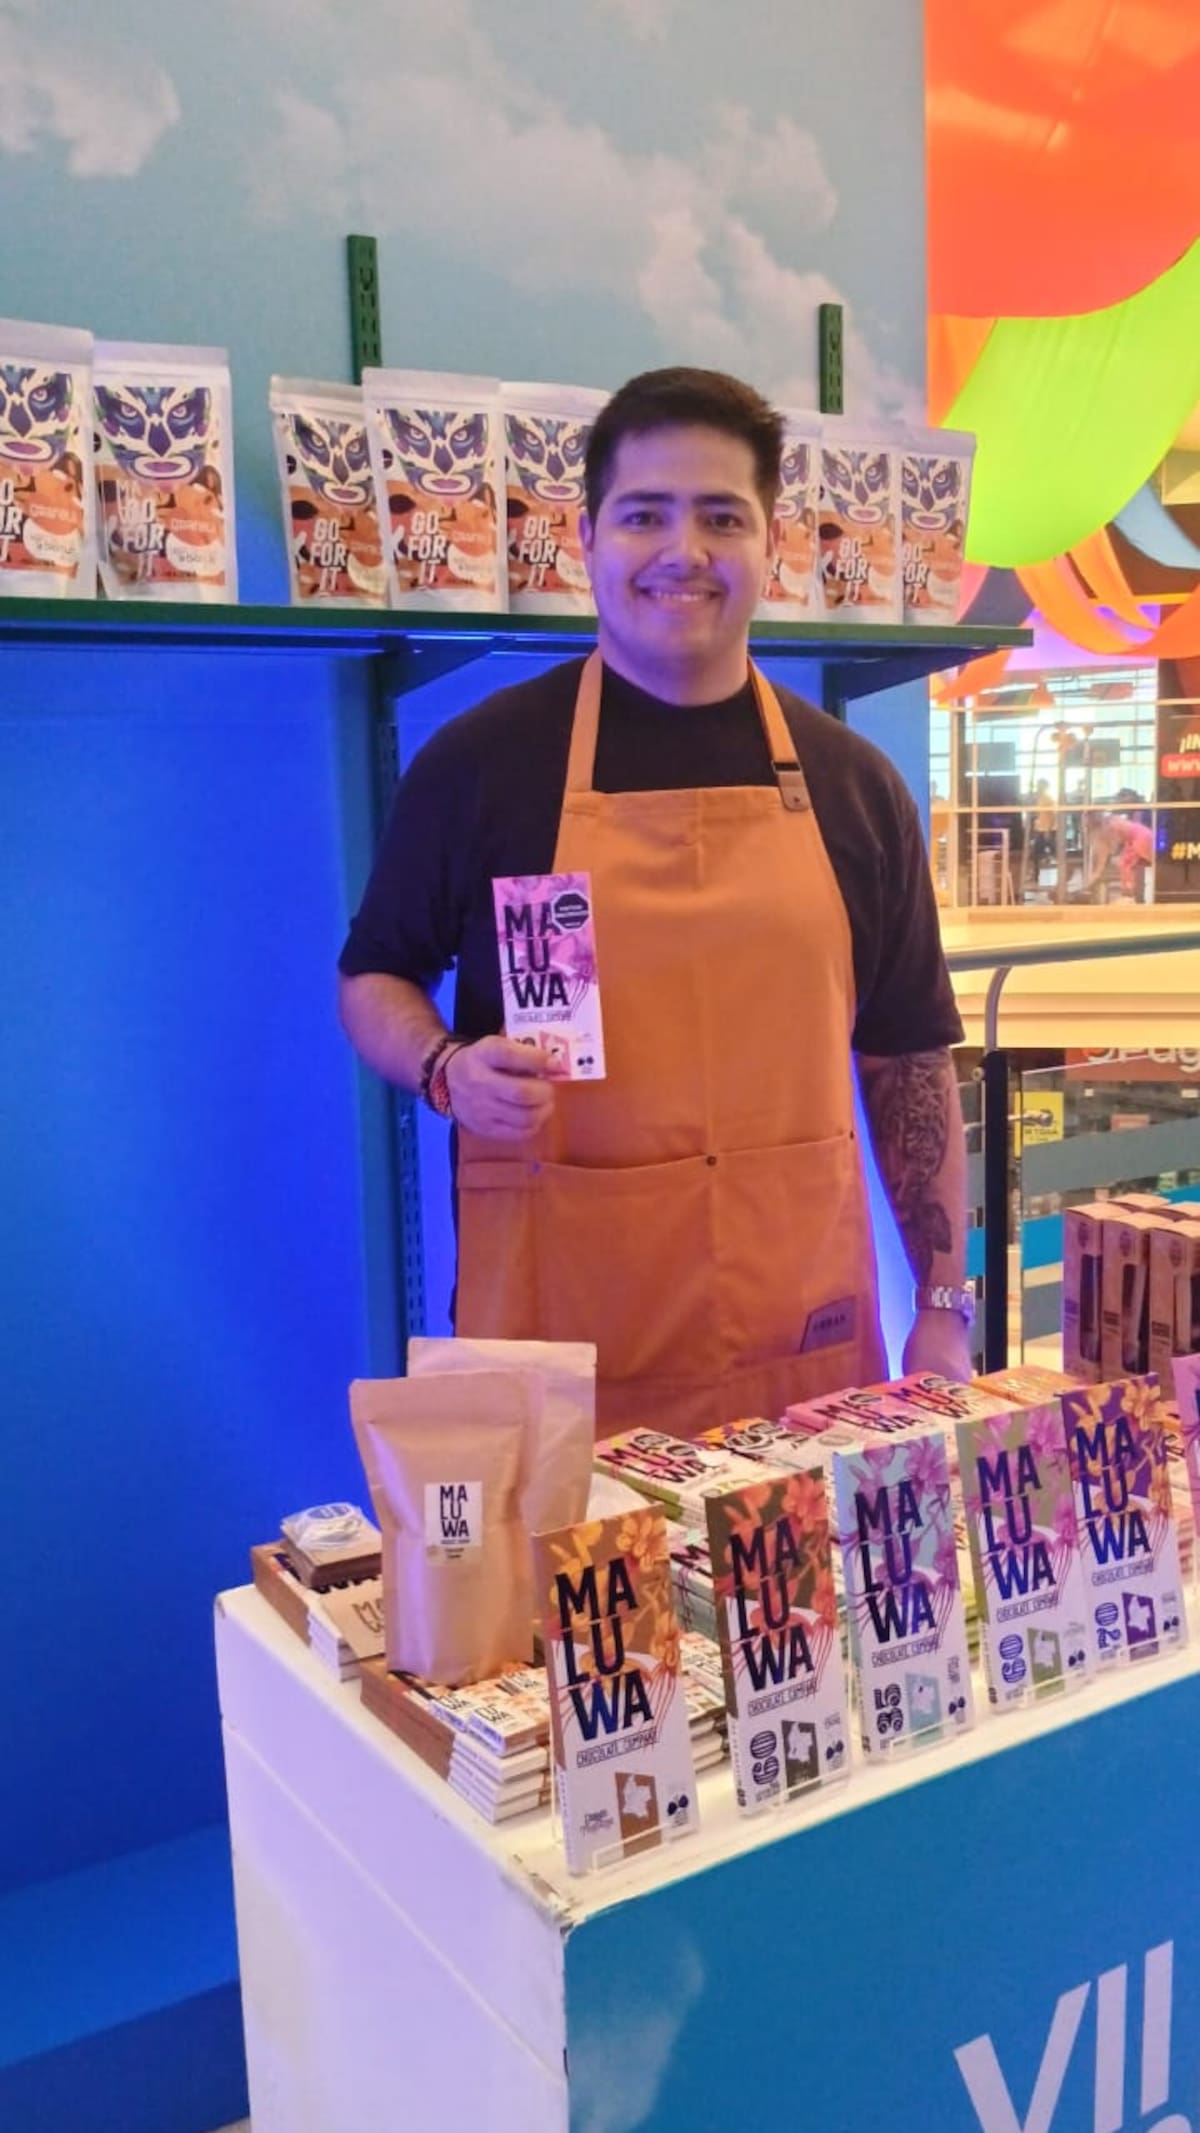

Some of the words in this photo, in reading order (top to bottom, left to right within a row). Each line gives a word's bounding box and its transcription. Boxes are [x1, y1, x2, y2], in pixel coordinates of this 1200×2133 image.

[0, 479, 14, 507] O
[313, 518, 340, 542] GO
[411, 511, 439, 535] GO
[523, 515, 551, 540] GO
[309, 541, 347, 566] FOR
[407, 534, 447, 560] FOR
[519, 539, 556, 563] FOR
[319, 566, 342, 591] IT
[418, 559, 440, 584] IT
[528, 562, 551, 588] IT
[835, 558, 868, 580] FOR
[903, 561, 927, 584] OR
[504, 902, 562, 938] MA
[507, 938, 550, 975] LU
[510, 973, 570, 1010] WA
[1076, 1416, 1138, 1471] MA
[621, 1453, 675, 1477] LU
[651, 1458, 709, 1485] WA
[976, 1444, 1042, 1505] MA
[440, 1484, 468, 1502] MA
[440, 1500, 462, 1520] LU
[855, 1479, 923, 1544] MA
[1082, 1468, 1130, 1520] LU
[441, 1519, 470, 1537] WA
[983, 1495, 1033, 1553] LU
[1087, 1510, 1152, 1566] WA
[729, 1516, 799, 1588] MA
[861, 1532, 913, 1594] LU
[989, 1541, 1057, 1600] WA
[556, 1557, 639, 1632] MA
[735, 1573, 791, 1640] LU
[865, 1581, 937, 1644] WA
[563, 1616, 626, 1686] LU
[741, 1623, 815, 1692] WA
[998, 1633, 1027, 1684] 60
[568, 1668, 655, 1742] WA
[873, 1683, 904, 1735] 35
[576, 1741, 620, 1768] CHOCOLATE
[749, 1730, 780, 1786] 60
